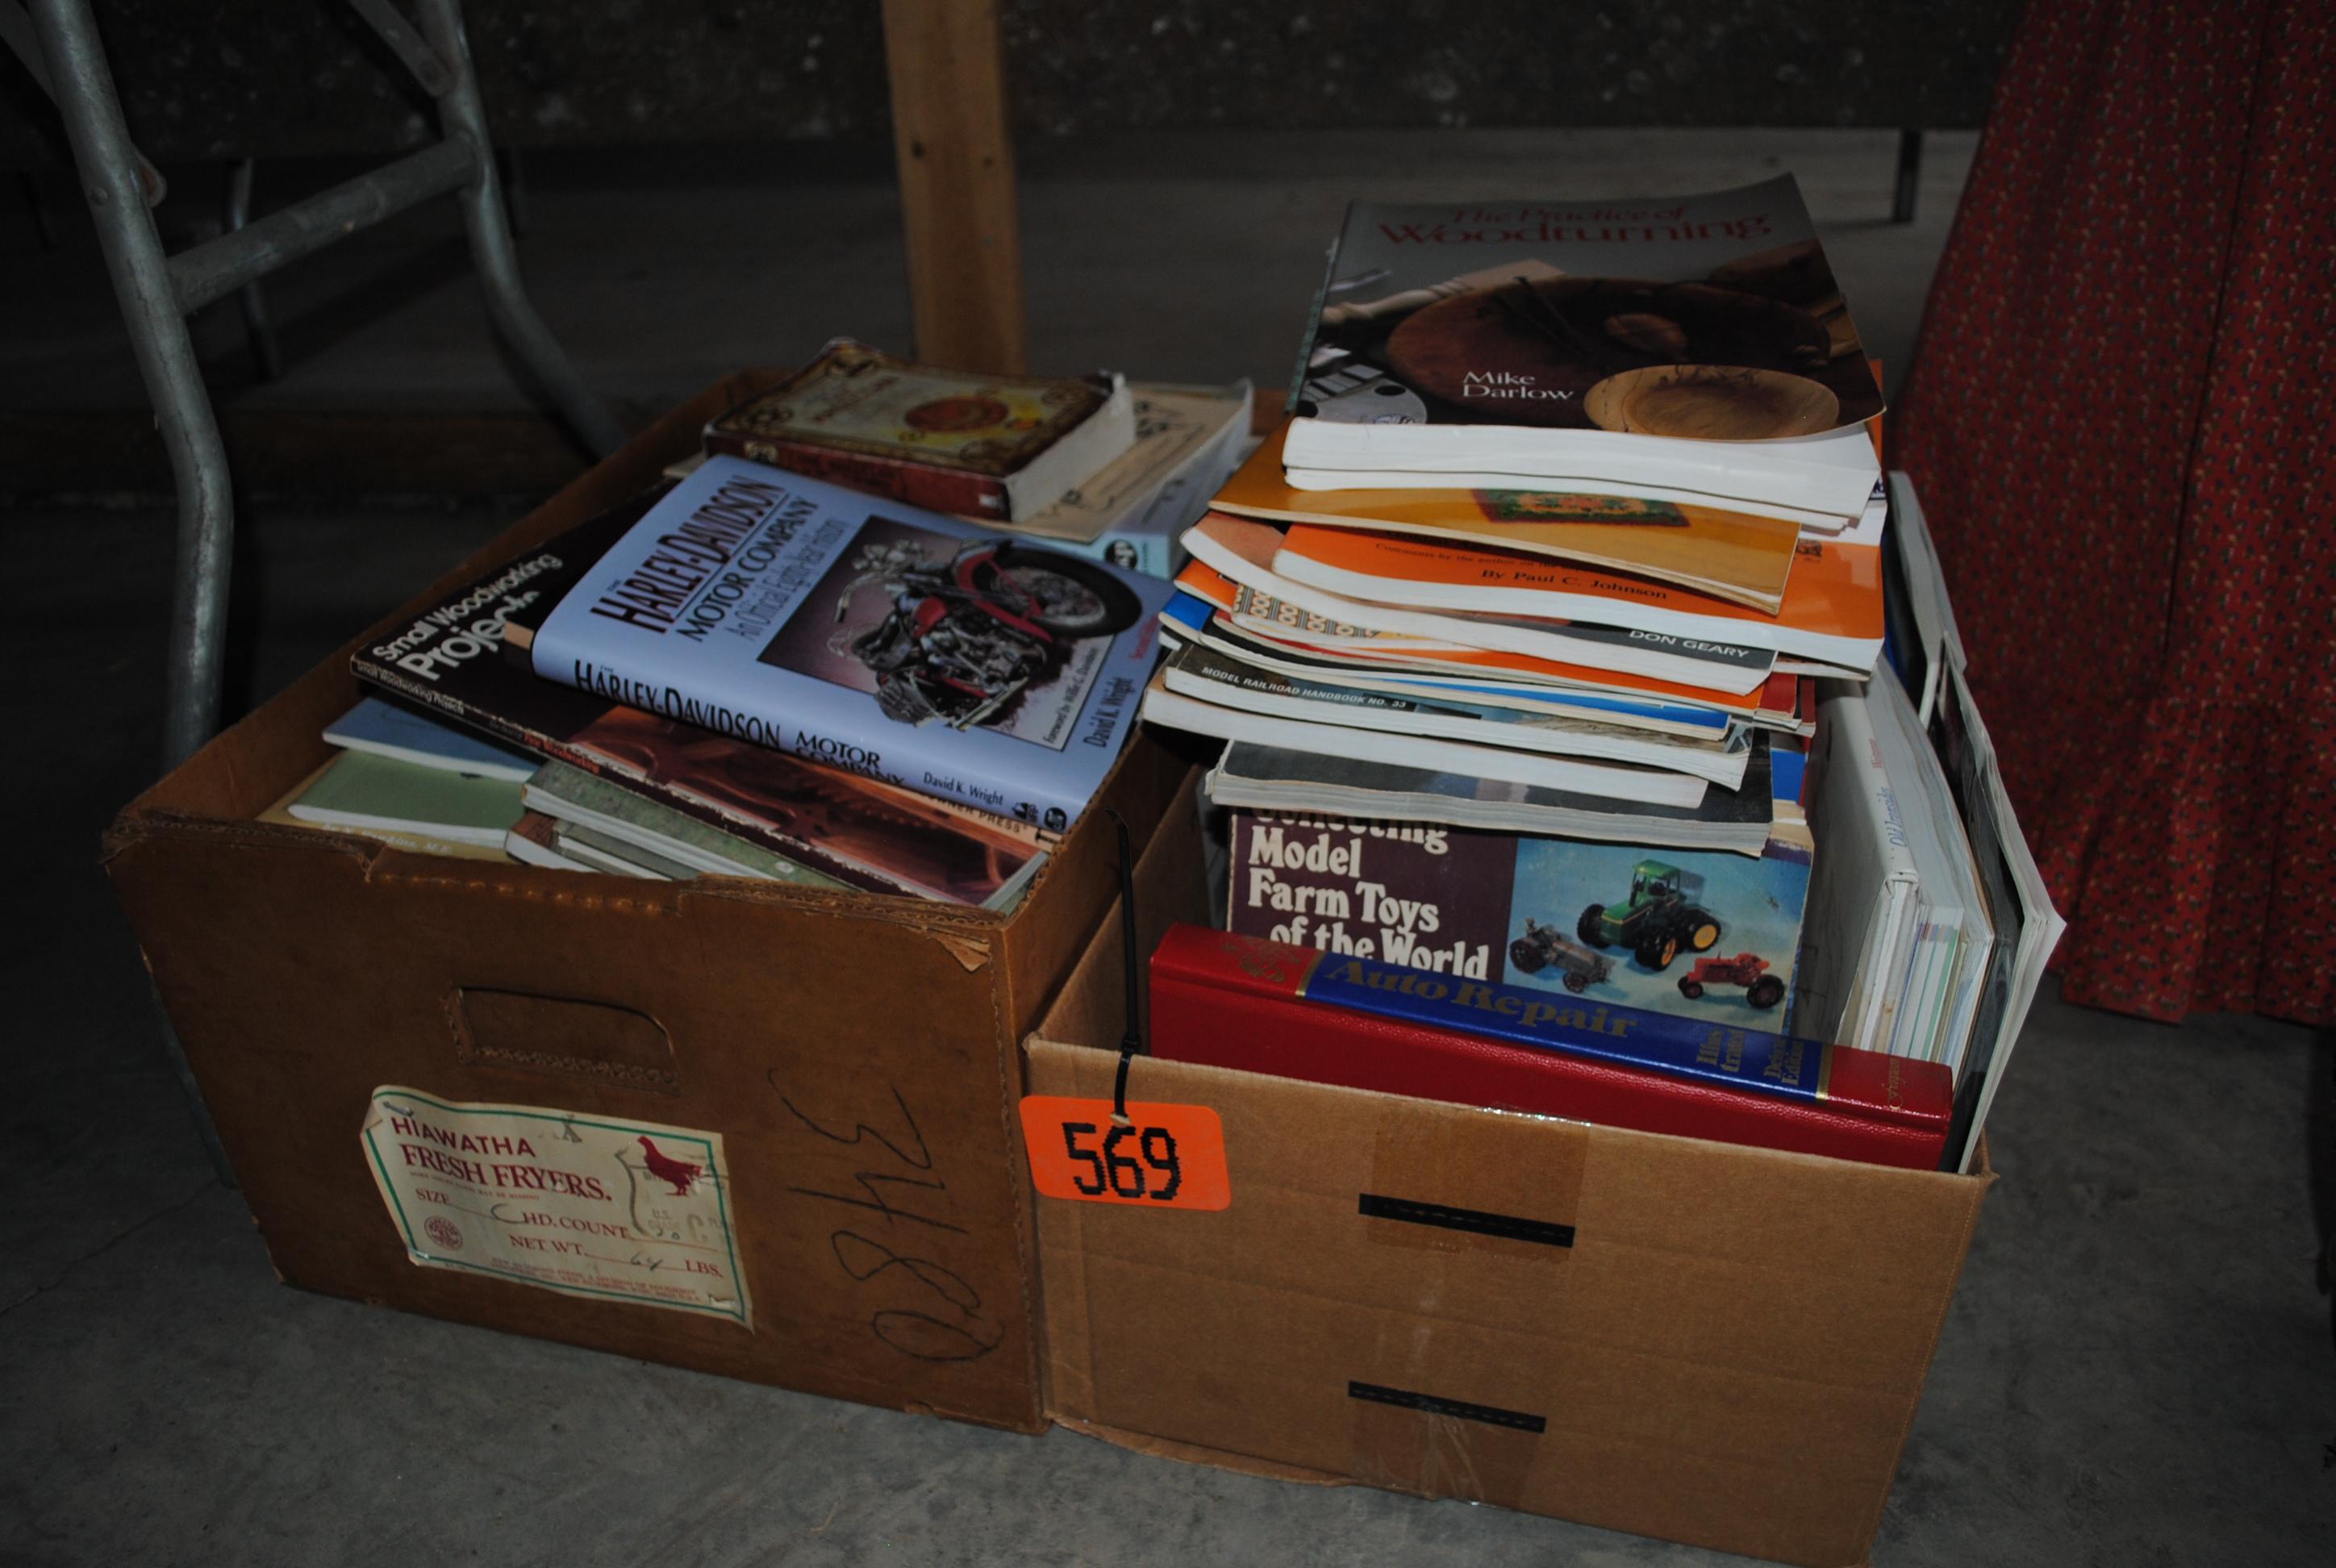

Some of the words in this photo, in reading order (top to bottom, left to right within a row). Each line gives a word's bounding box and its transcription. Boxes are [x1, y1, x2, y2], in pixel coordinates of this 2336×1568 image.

[1379, 213, 1773, 244] Woodturning
[1453, 206, 1508, 223] The
[1520, 206, 1648, 223] Practice
[1653, 206, 1692, 222] of
[1462, 370, 1536, 386] Mike
[1462, 384, 1575, 401] Darlow
[590, 474, 785, 634] HARLEY-DAVIDSON
[676, 573, 754, 642] MOTOR
[739, 496, 819, 573] COMPANY
[1481, 569, 1504, 580] By
[1513, 570, 1554, 585] Paul
[1562, 575, 1582, 588] C.
[1589, 579, 1668, 599] Johnson
[372, 619, 440, 662] Small
[424, 553, 563, 627] Woodworking
[1629, 630, 1677, 645] DON
[1683, 640, 1750, 658] GEARY
[574, 660, 780, 749] HARLEY-DAVIDSON
[1201, 666, 1240, 683] MODEL
[1243, 678, 1300, 695] RAILROAD
[1302, 688, 1366, 703] HANDBOOK
[1367, 696, 1387, 707] NO.
[1391, 700, 1408, 709] 33
[1083, 715, 1116, 749] David
[1100, 677, 1136, 707] Wright
[796, 731, 880, 768] MOTOR
[924, 771, 954, 792] David
[955, 782, 966, 794] K.
[969, 784, 1003, 806] Wright
[1248, 825, 1362, 878] Model
[1247, 867, 1350, 920] Farm
[1355, 880, 1441, 933] Toys
[1270, 915, 1309, 946] of
[1314, 921, 1376, 960] the
[1380, 928, 1490, 981] World
[1324, 960, 1450, 1000] Auto
[1450, 982, 1638, 1037] Repair
[390, 1116, 536, 1157] HIAWATHA
[398, 1143, 488, 1186] FRESH
[490, 1163, 613, 1202] FRYERS.
[1062, 1122, 1182, 1200] 569
[415, 1187, 450, 1205] SIZE
[509, 1233, 545, 1251] NET
[552, 1241, 586, 1257] WT.
[522, 1211, 557, 1228] HD.
[559, 1216, 630, 1239] COUNT
[685, 1259, 724, 1278] LBS.
